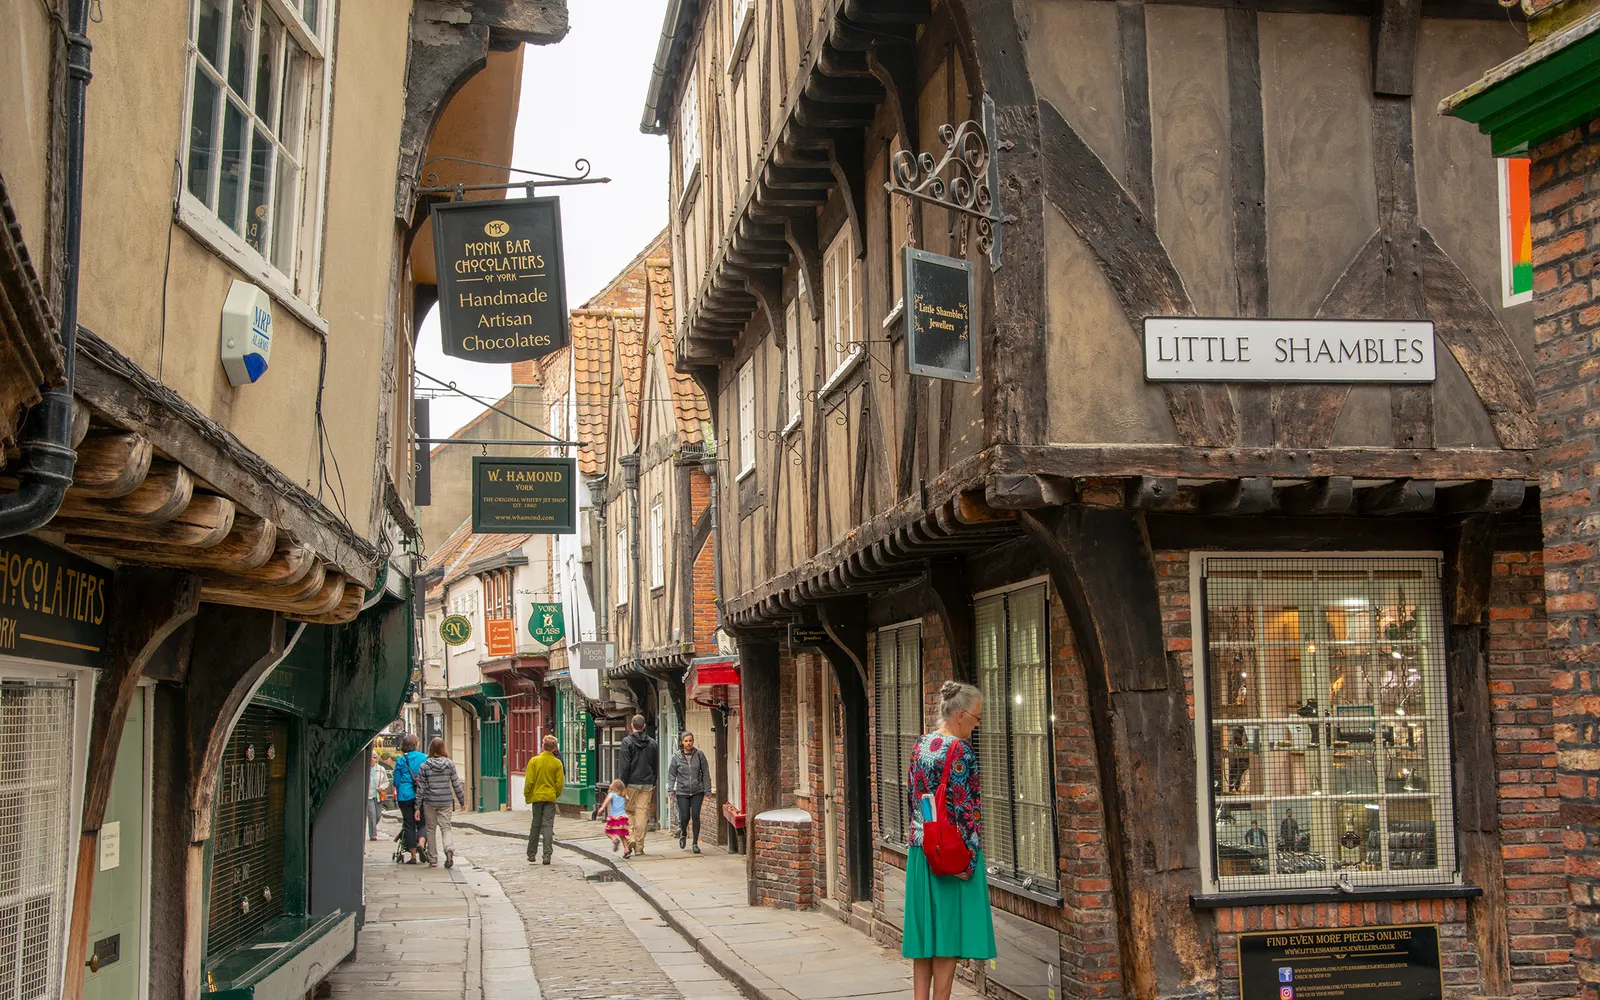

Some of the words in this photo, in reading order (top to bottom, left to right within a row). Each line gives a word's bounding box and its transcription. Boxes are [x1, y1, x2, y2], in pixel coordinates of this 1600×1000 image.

[465, 242, 501, 256] MONK
[506, 239, 532, 254] BAR
[455, 255, 545, 274] CHOCOLATIERS
[484, 274, 494, 283] OF
[496, 273, 517, 282] YORK
[459, 287, 548, 307] Handmade
[253, 306, 271, 333] MRP
[919, 303, 935, 315] Little
[936, 306, 964, 320] Shambles
[477, 312, 533, 329] Artisan
[929, 318, 955, 331] Jewellers
[462, 333, 550, 350] Chocolates
[1157, 336, 1252, 363] LITTLE
[1274, 337, 1424, 364] SHAMBLES
[487, 469, 503, 482] W.
[507, 471, 562, 482] HAMOND
[537, 605, 558, 613] YORK
[0, 617, 17, 649] RK
[446, 623, 465, 638] N
[535, 627, 561, 635] GLASS
[1266, 936, 1288, 947] FIND
[1290, 935, 1314, 945] EVEN
[1316, 934, 1342, 944] MORE
[1344, 932, 1376, 942] PIECES
[1376, 930, 1412, 941] ONLINE!
